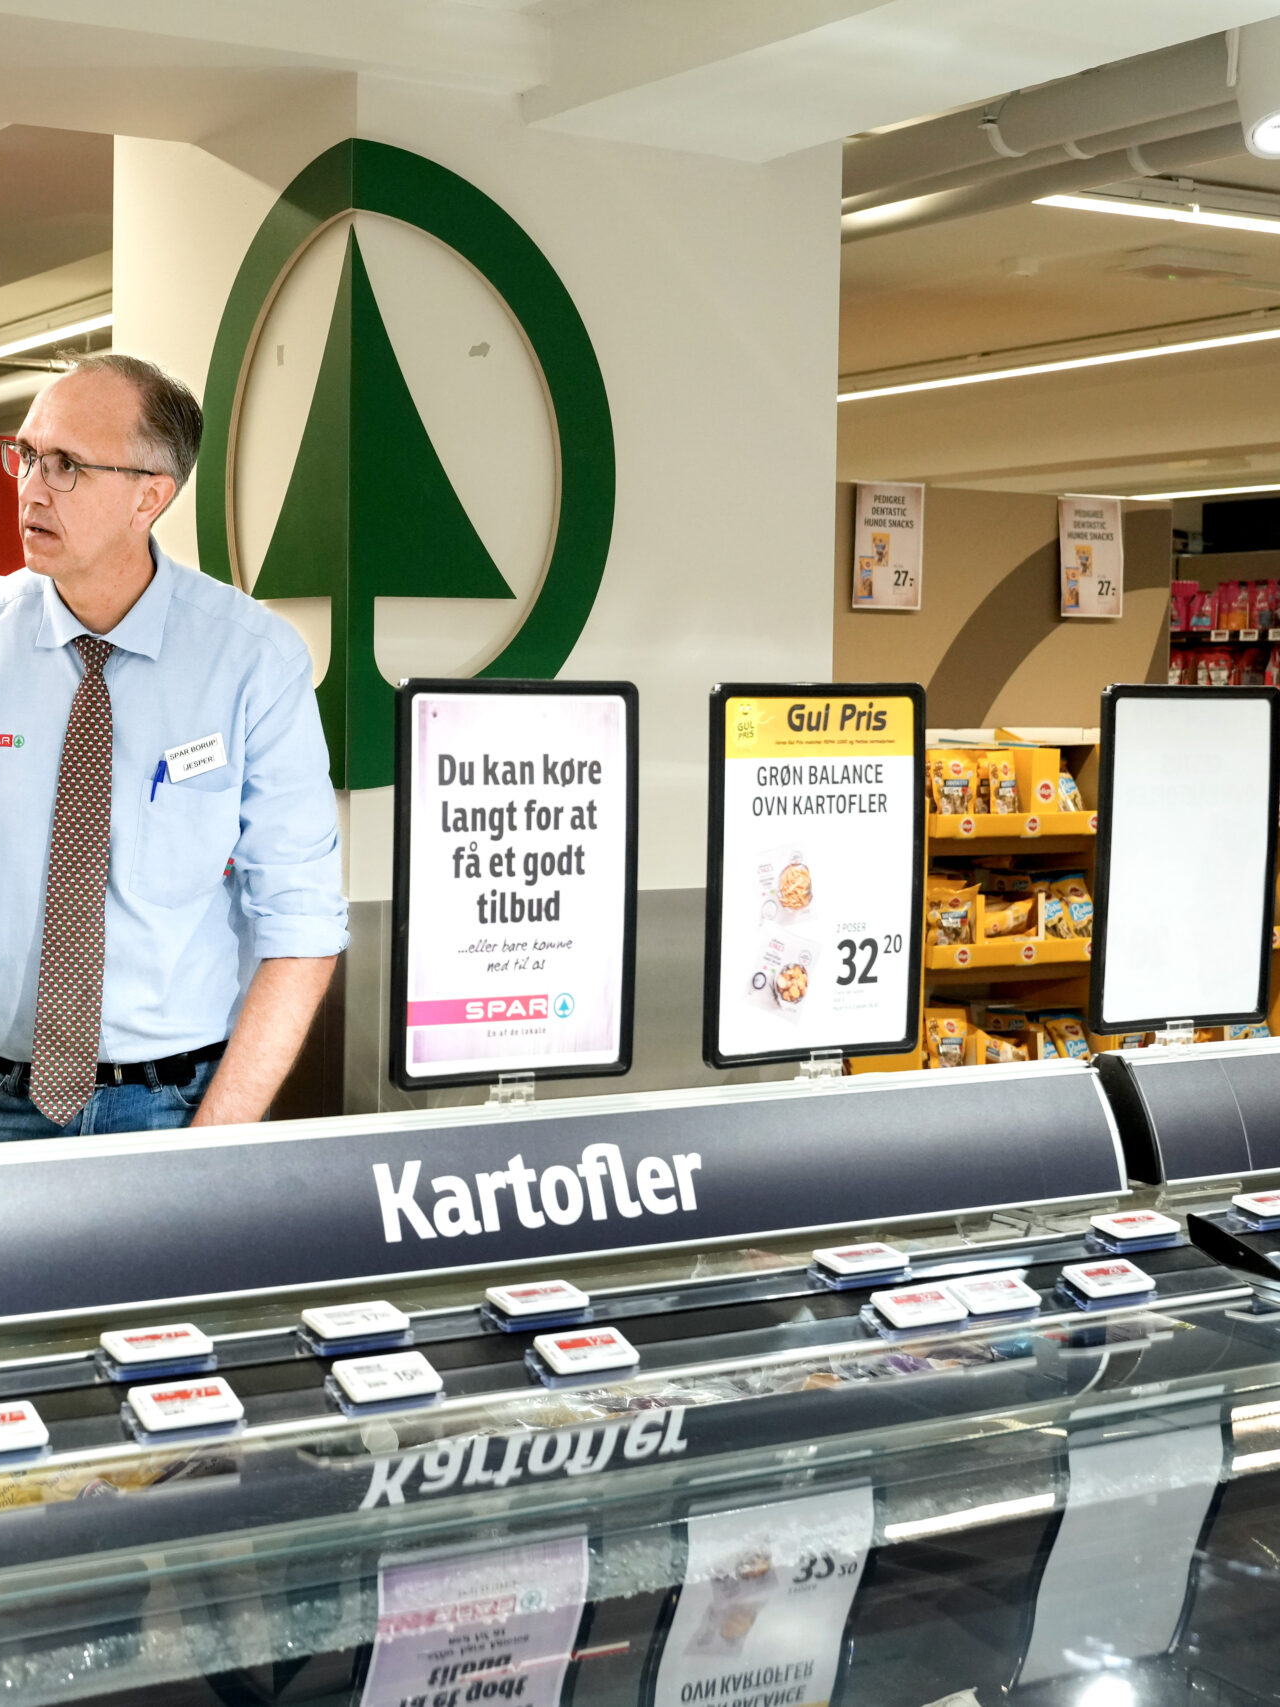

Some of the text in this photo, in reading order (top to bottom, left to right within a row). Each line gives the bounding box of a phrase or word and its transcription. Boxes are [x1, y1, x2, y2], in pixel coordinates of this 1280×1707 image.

[873, 494, 905, 505] PEDIGREE
[864, 518, 914, 529] HUNDE SNACKS
[737, 721, 755, 732] GUL
[787, 701, 888, 732] Gul Pris
[738, 731, 754, 740] PRIS
[169, 739, 216, 761] SPAR BORUP
[185, 756, 213, 771] JESPER
[437, 753, 602, 787] Du kan køre
[757, 763, 884, 787] GRØN BALANCE
[752, 793, 888, 817] OVN KARTOFLER
[441, 799, 597, 841] langt for at
[452, 840, 586, 886] få et godt
[476, 888, 561, 925] tilbud
[501, 937, 528, 953] bare
[532, 938, 573, 952] komme
[487, 959, 510, 973] ned
[513, 956, 530, 971] til
[836, 933, 903, 986] 32 20
[465, 998, 548, 1020] SPAR
[372, 1142, 703, 1244] Kartofler
